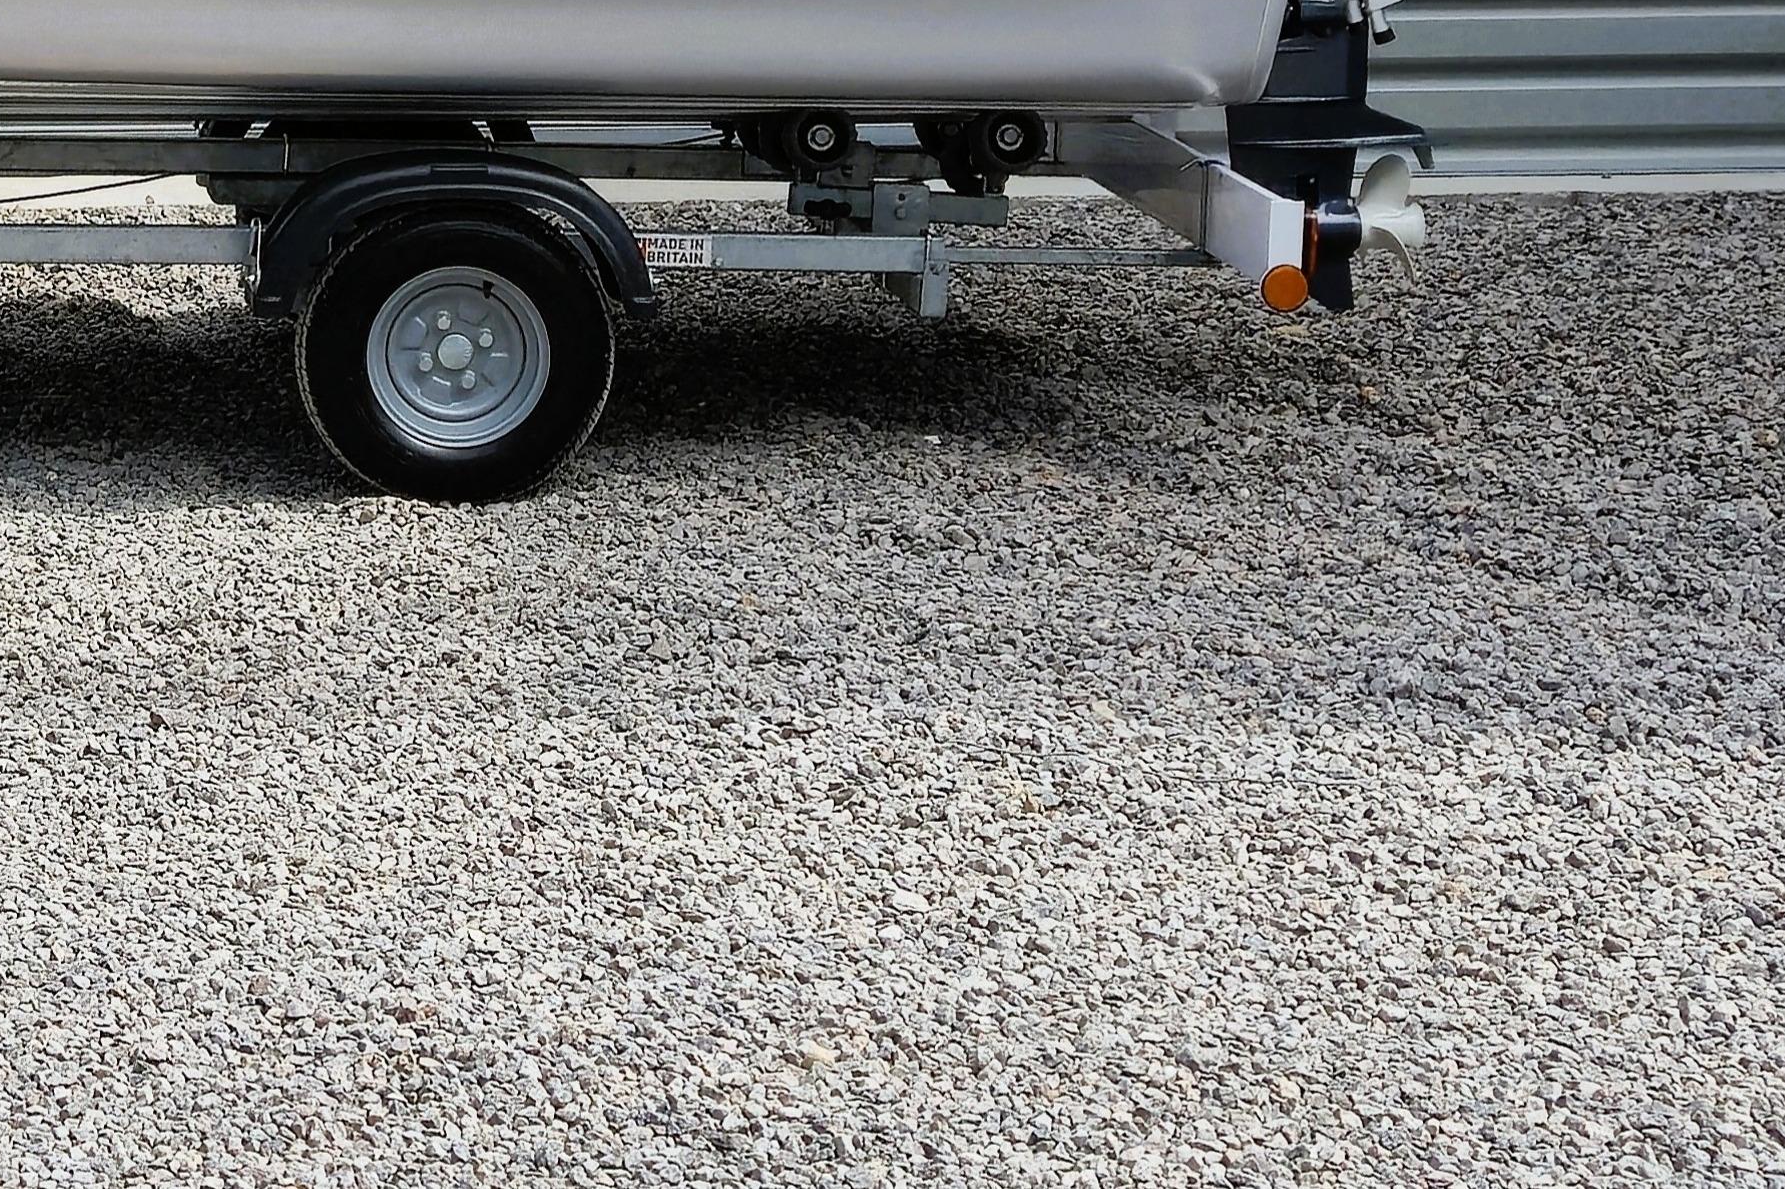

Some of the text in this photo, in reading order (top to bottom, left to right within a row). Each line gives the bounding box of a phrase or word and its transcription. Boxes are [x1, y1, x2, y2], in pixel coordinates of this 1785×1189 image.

[647, 238, 704, 250] MADE IN
[647, 251, 703, 264] BRITAIN
